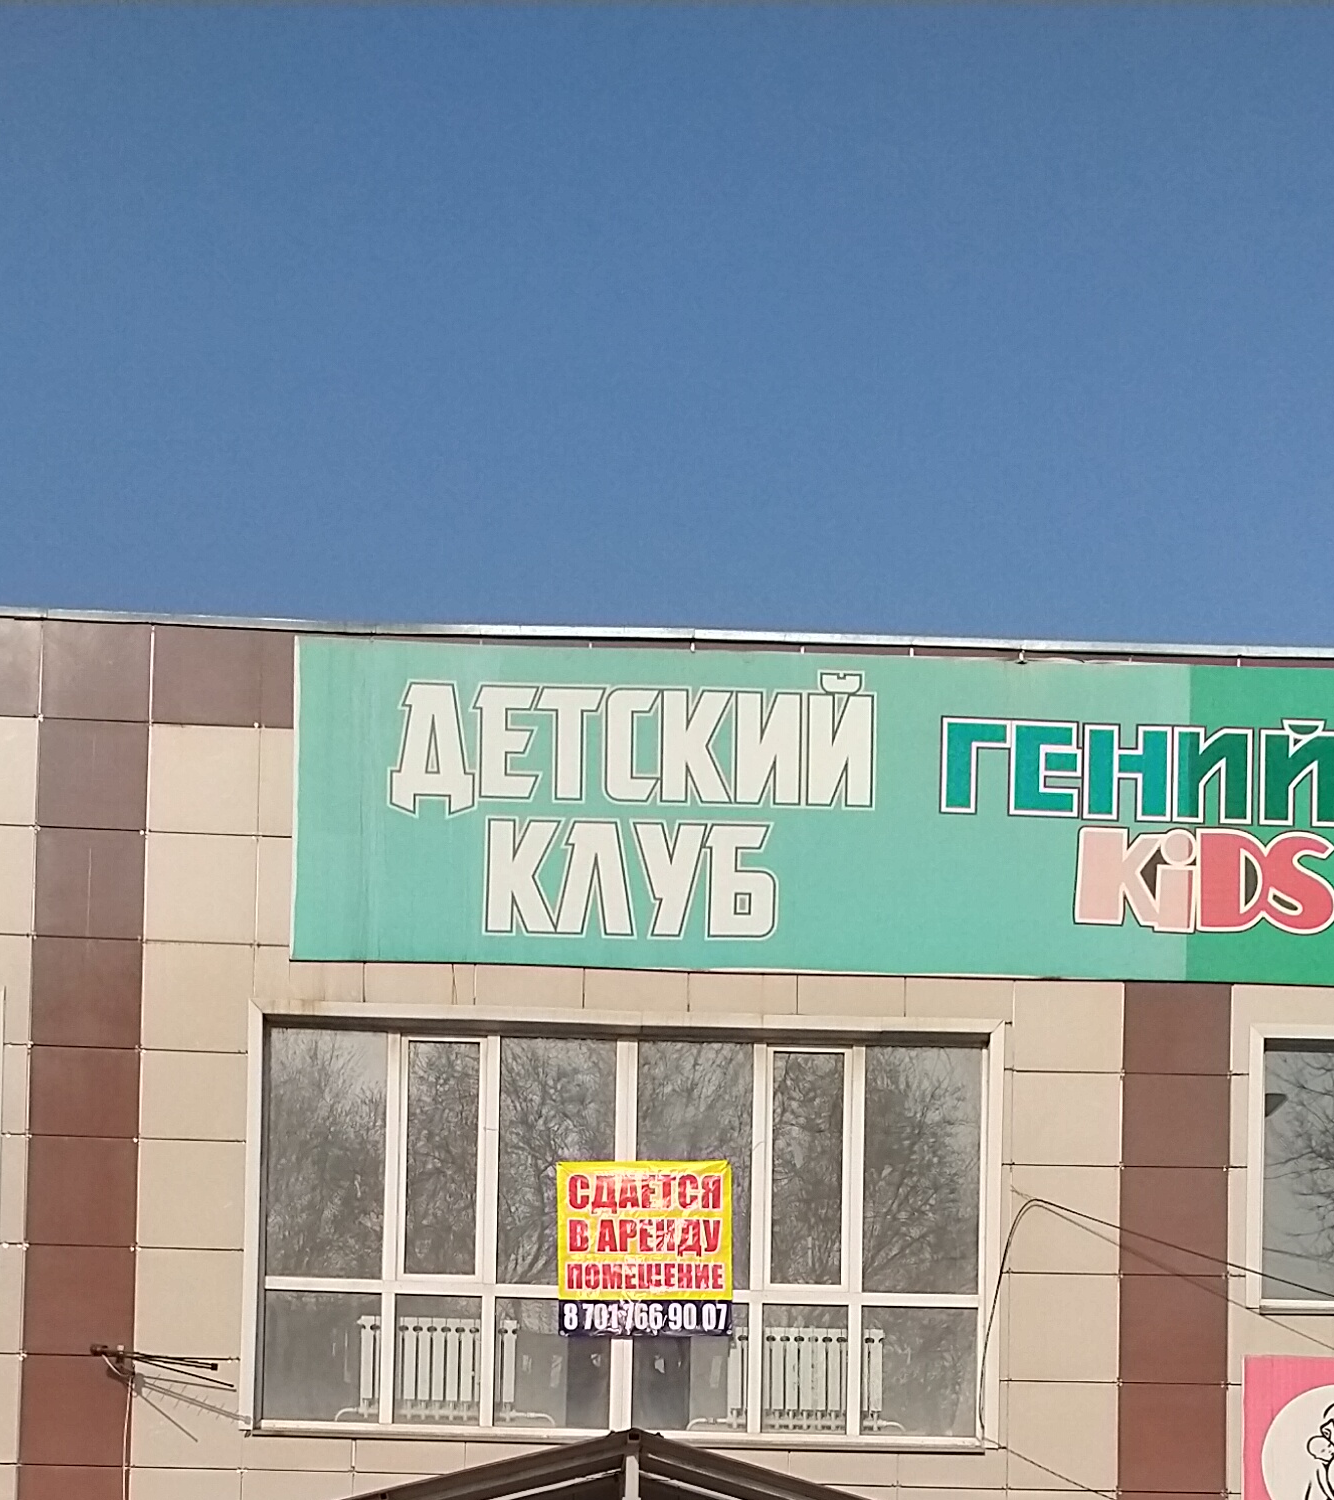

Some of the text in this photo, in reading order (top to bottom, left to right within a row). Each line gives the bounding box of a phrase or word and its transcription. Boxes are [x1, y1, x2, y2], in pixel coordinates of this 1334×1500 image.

[387, 671, 877, 818] ДЕТСКИЙ
[483, 818, 778, 941] КЛУБ
[568, 1173, 721, 1214] СДАЕТСЯ
[569, 1219, 722, 1257] В АРЕНДУ
[567, 1263, 724, 1290] ПОМЕЩЕНИЕ
[563, 1303, 578, 1330] 8
[668, 1303, 697, 1330] 90
[701, 1303, 728, 1331] 07
